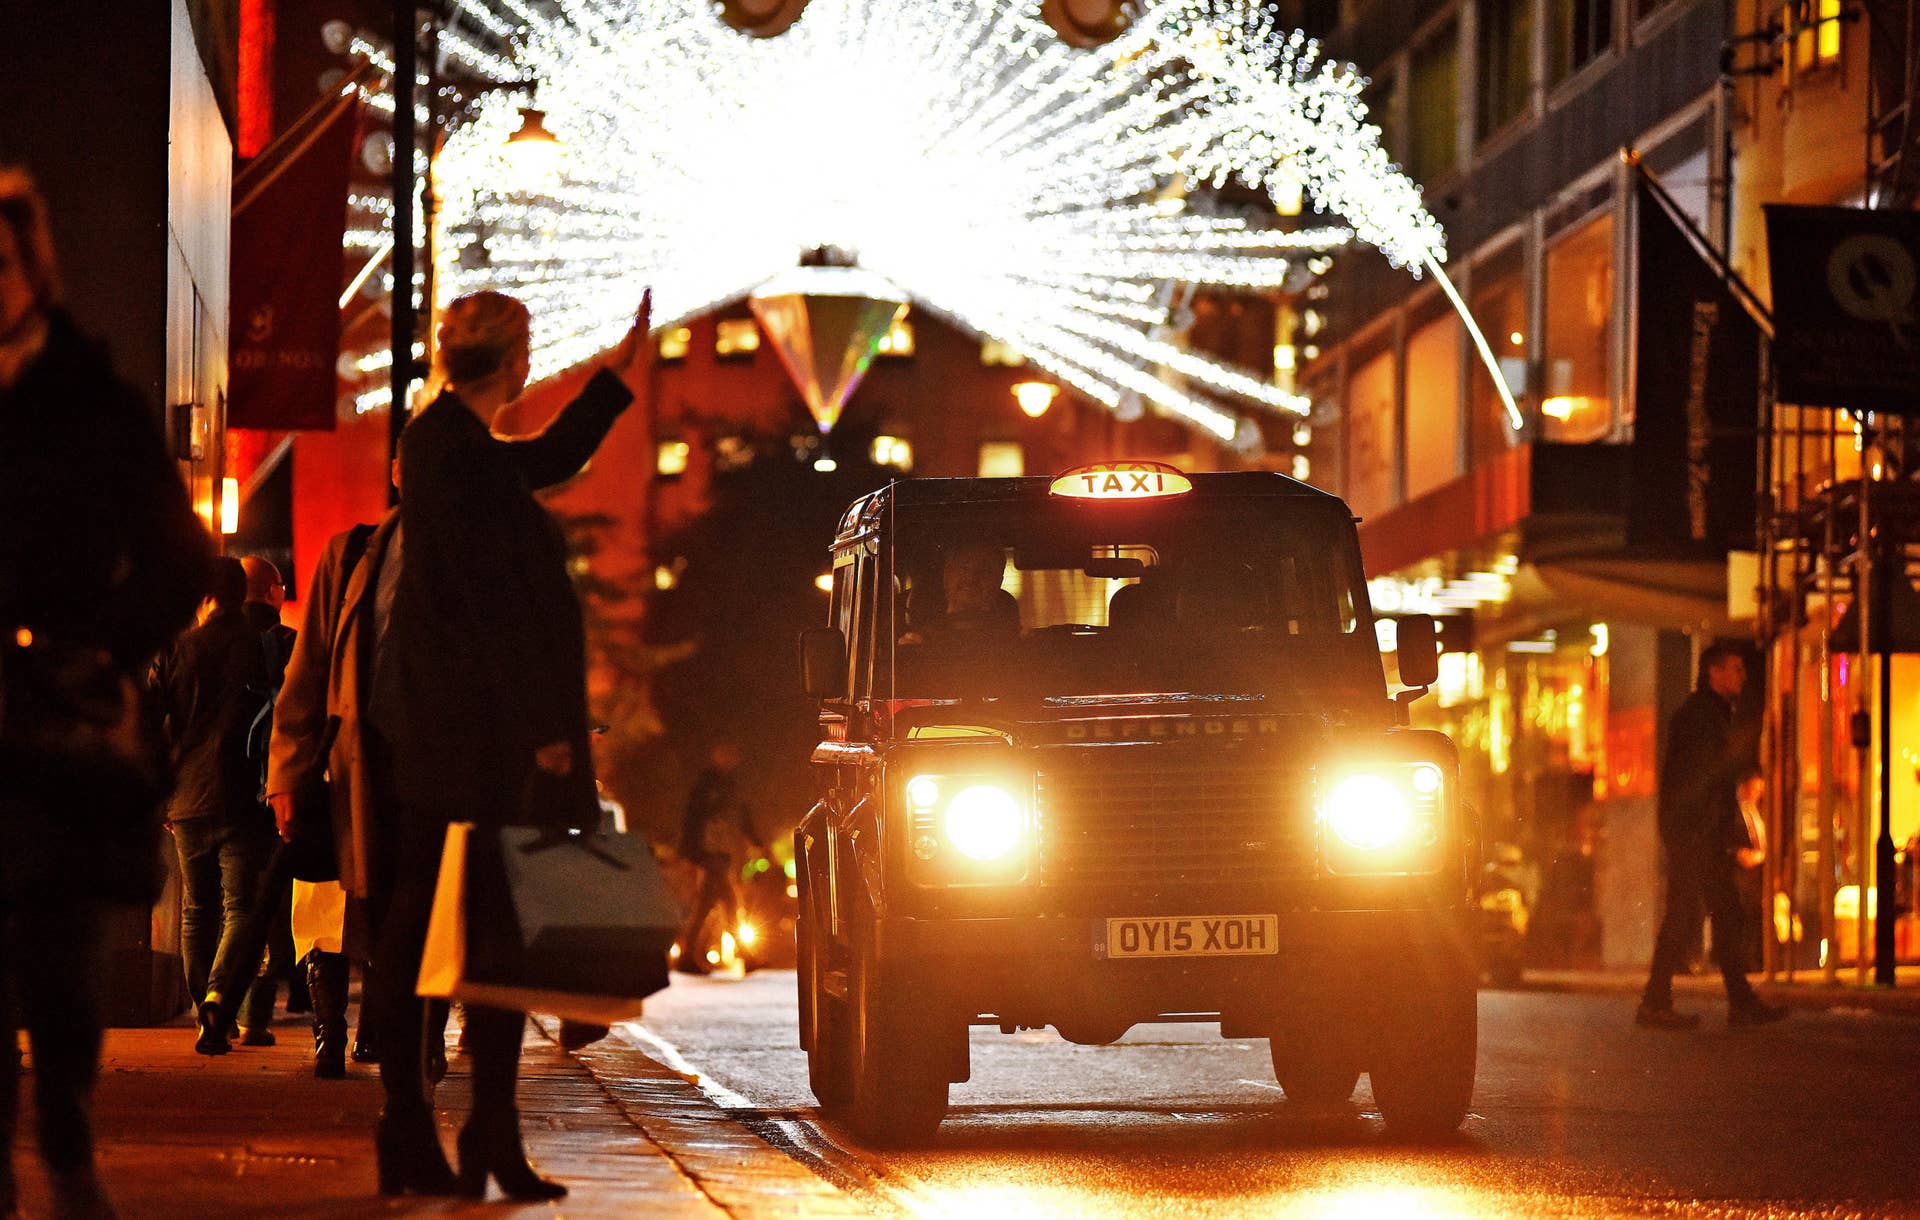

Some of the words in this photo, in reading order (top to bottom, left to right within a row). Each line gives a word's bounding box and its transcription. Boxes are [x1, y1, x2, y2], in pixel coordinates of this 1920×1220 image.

[1081, 473, 1163, 493] TAXI
[1066, 719, 1278, 738] DEFENDER
[1120, 921, 1192, 952] OY15
[1202, 919, 1266, 950] XOH
